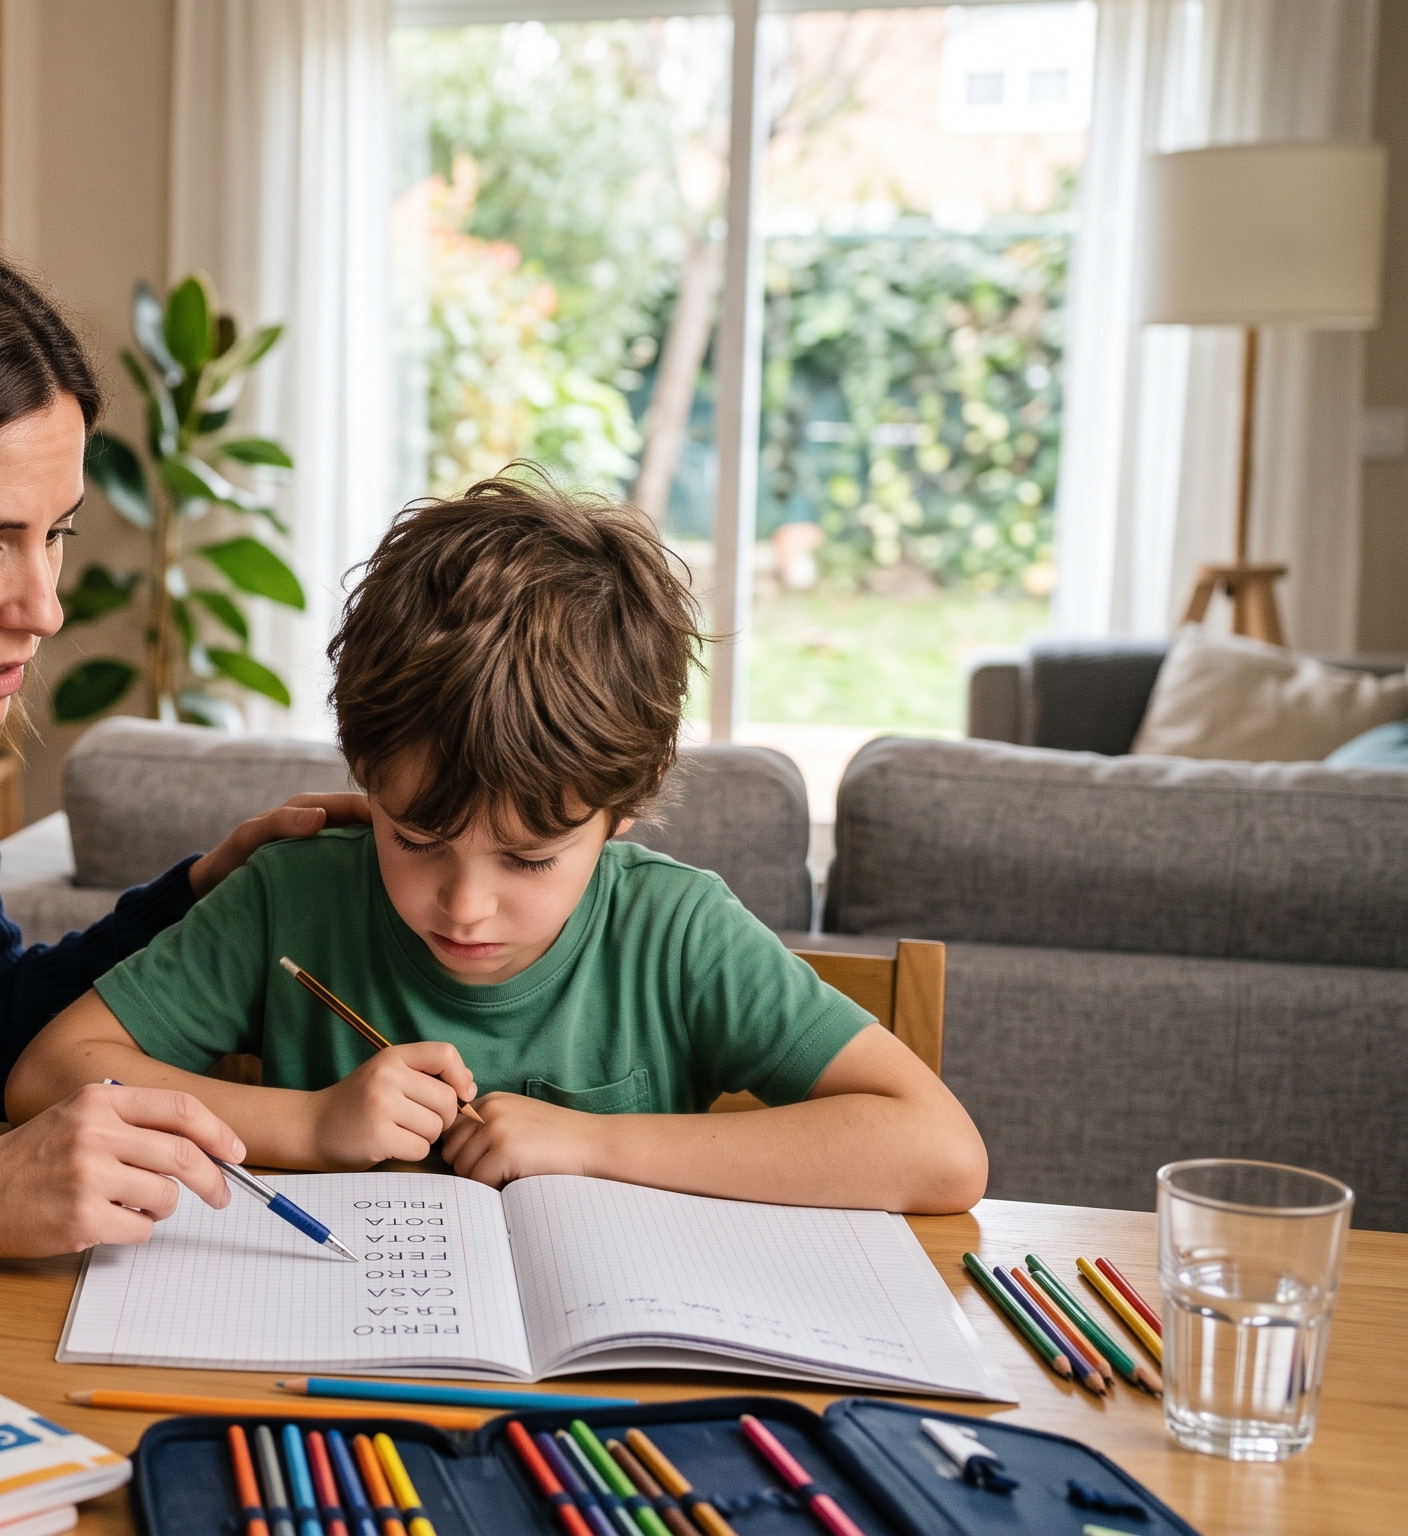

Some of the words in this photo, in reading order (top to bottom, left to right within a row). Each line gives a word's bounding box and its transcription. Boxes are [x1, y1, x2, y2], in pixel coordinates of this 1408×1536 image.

[365, 1217, 444, 1226] DOTA
[364, 1251, 447, 1261] FERO
[365, 1269, 452, 1279] CRRO
[367, 1287, 454, 1298] CASA
[353, 1324, 460, 1336] PERRO
